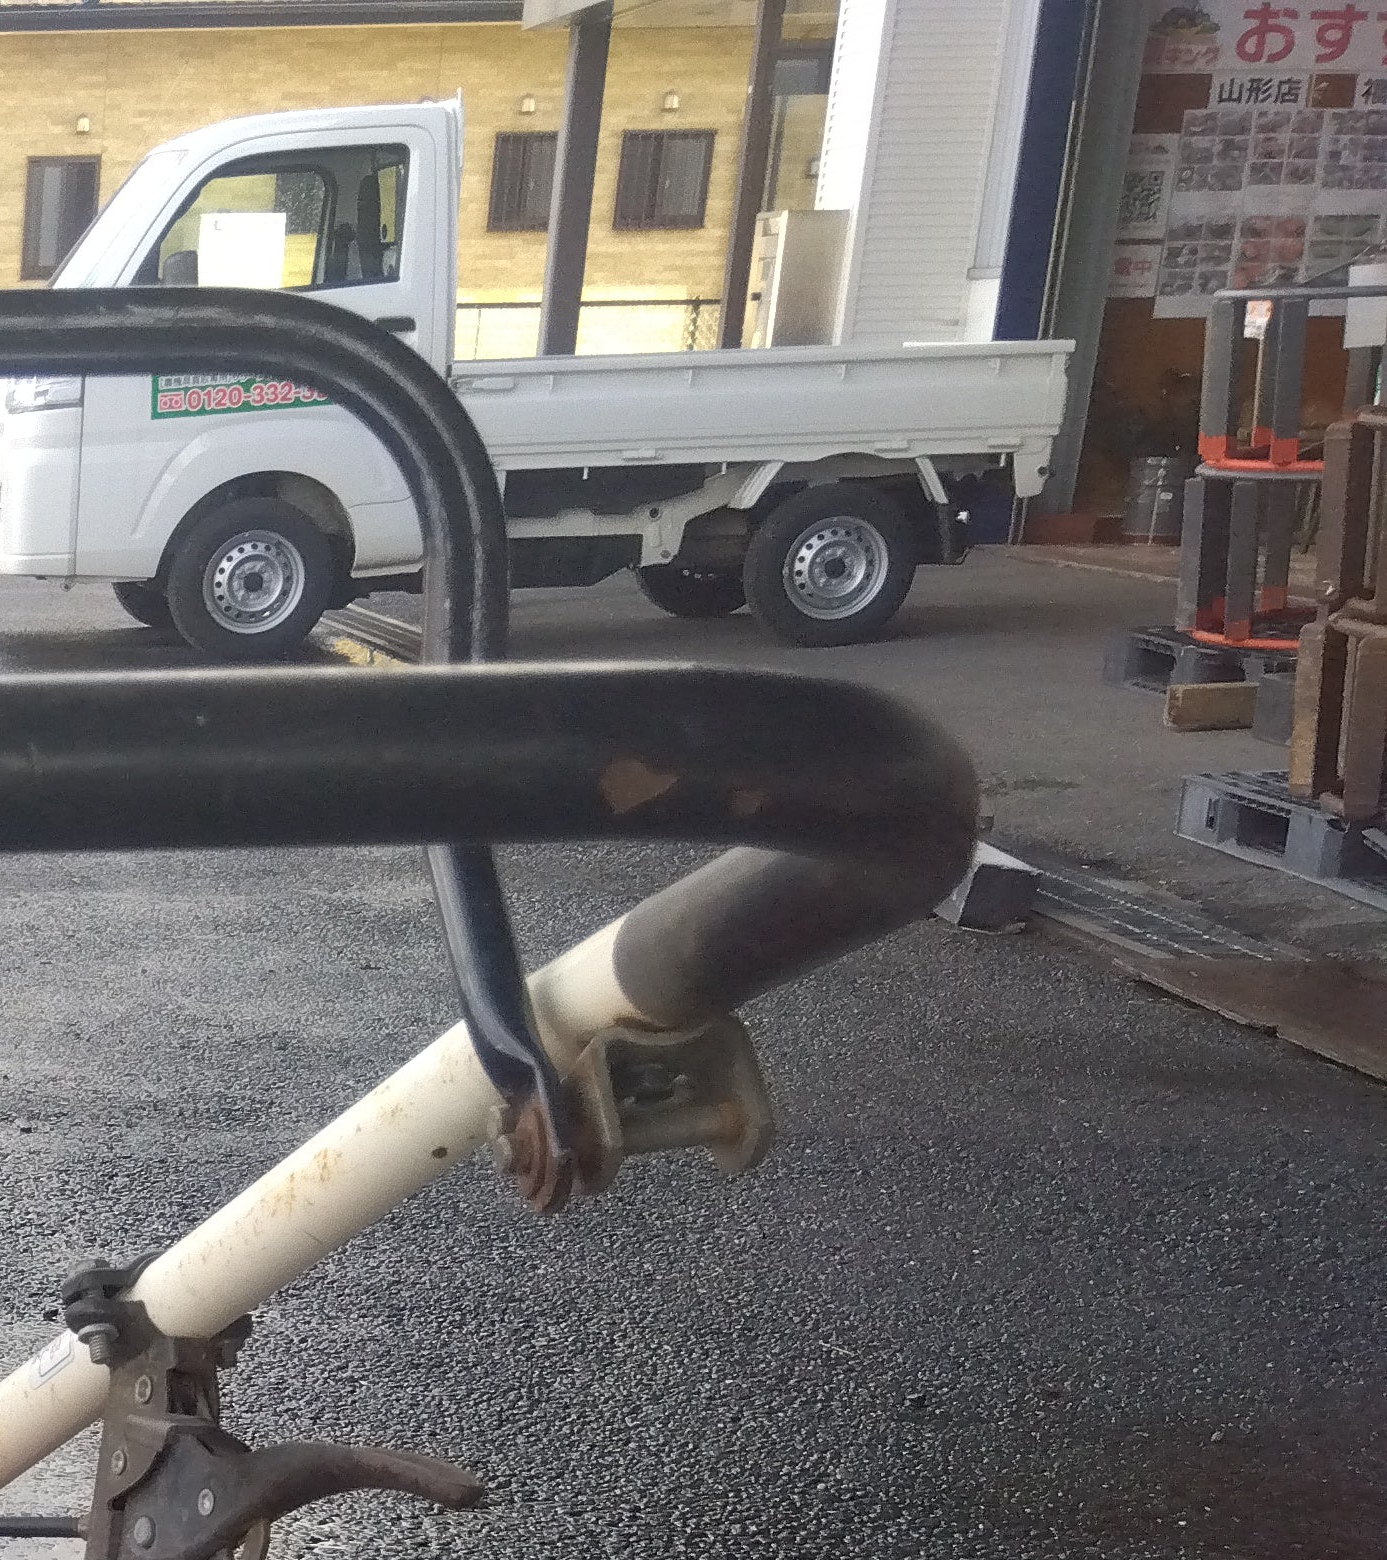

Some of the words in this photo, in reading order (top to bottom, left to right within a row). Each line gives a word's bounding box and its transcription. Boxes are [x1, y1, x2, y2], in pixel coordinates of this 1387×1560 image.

[1235, 2, 1387, 66] おす
[1218, 77, 1302, 104] 山形店
